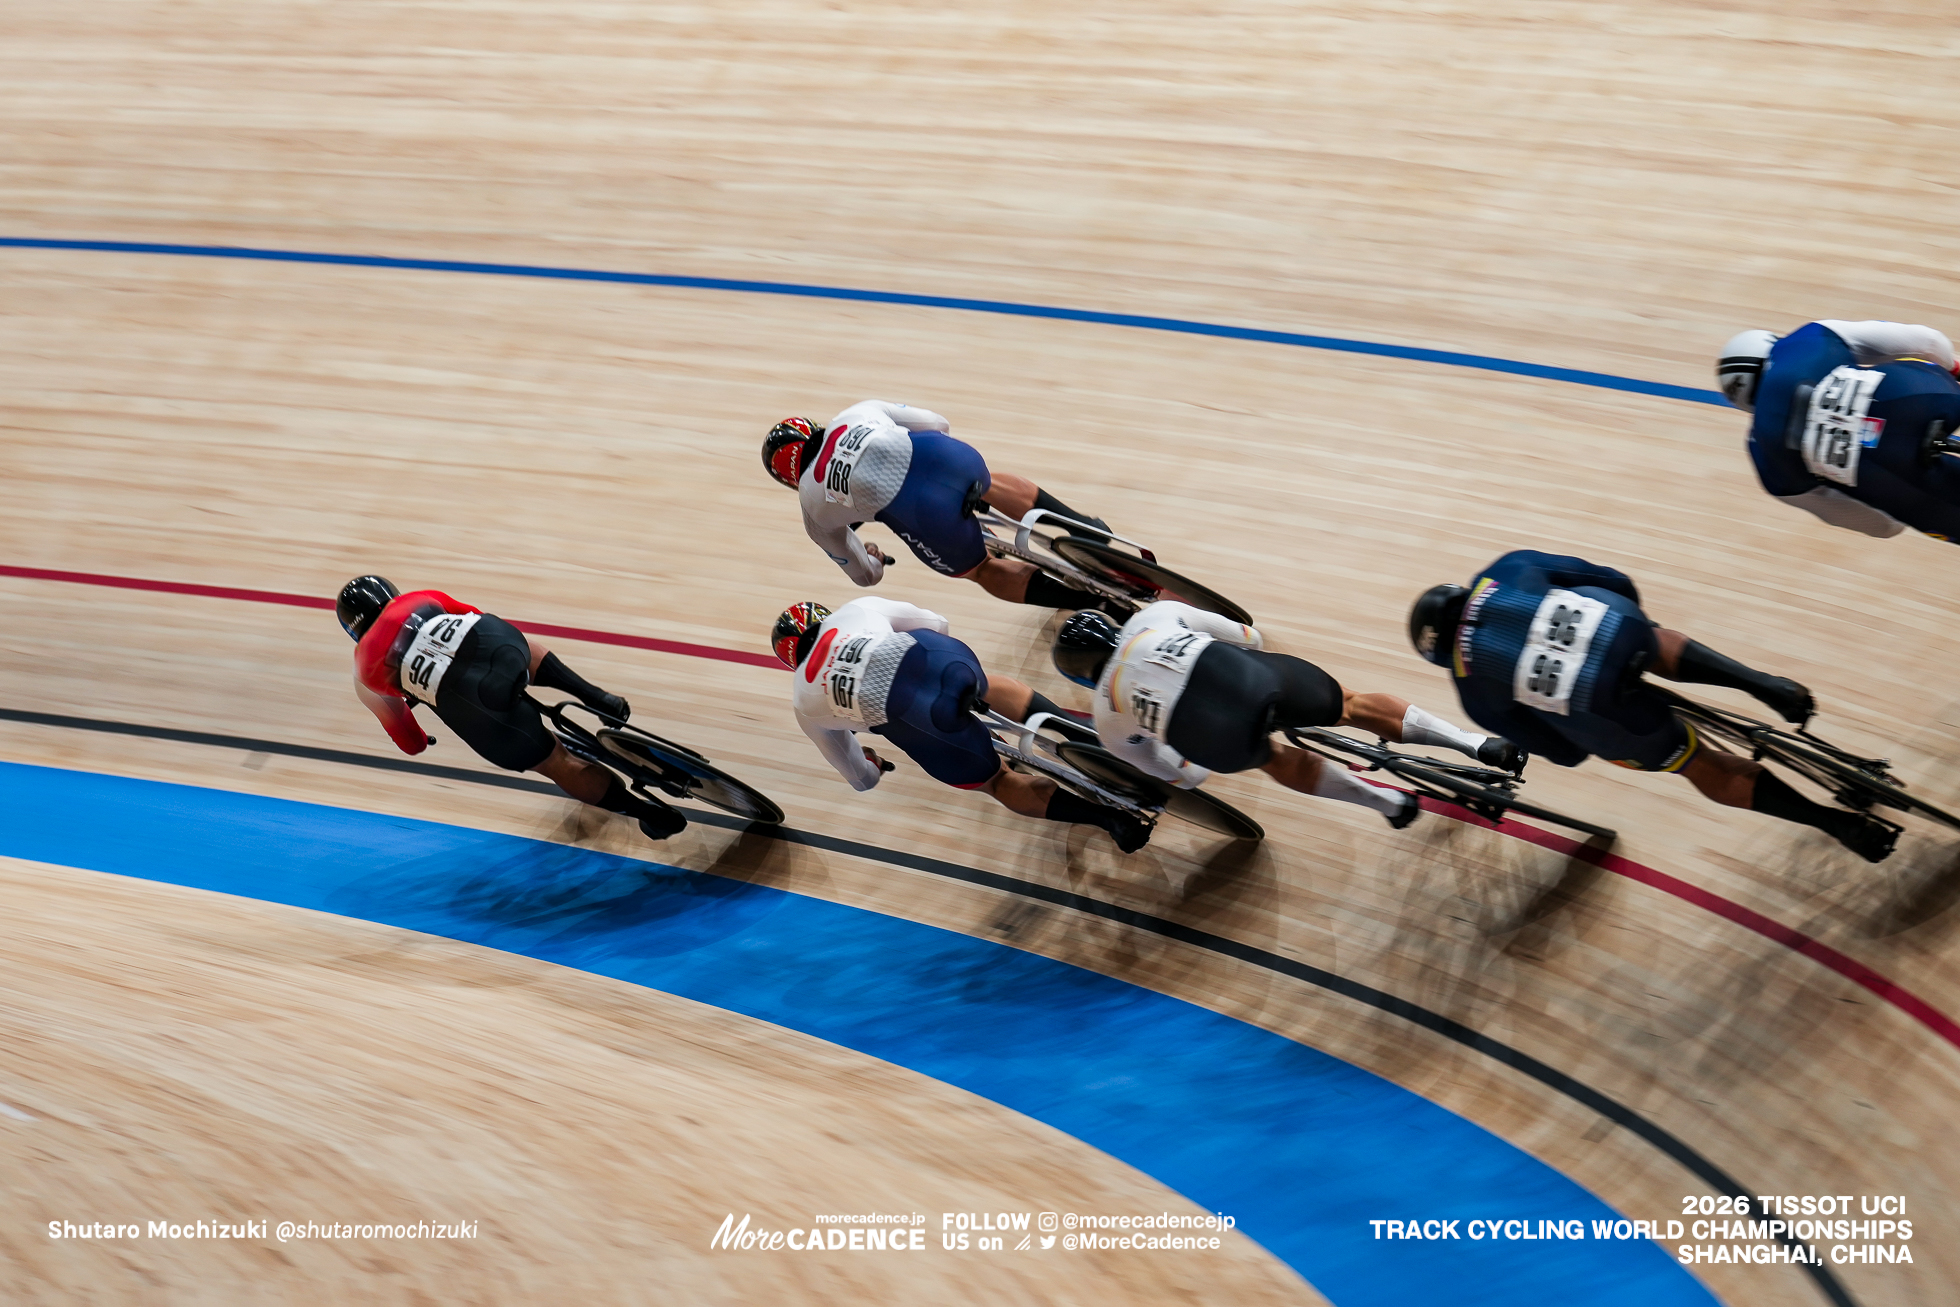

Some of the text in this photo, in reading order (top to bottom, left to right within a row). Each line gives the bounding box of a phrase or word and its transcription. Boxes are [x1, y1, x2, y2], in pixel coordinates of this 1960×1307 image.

[789, 445, 799, 482] JAPAN
[826, 458, 852, 496] 168
[900, 532, 955, 573] JAPAN
[820, 633, 852, 695] JAPAN
[837, 637, 874, 665] 167
[409, 654, 437, 691] 94
[830, 673, 856, 710] 167
